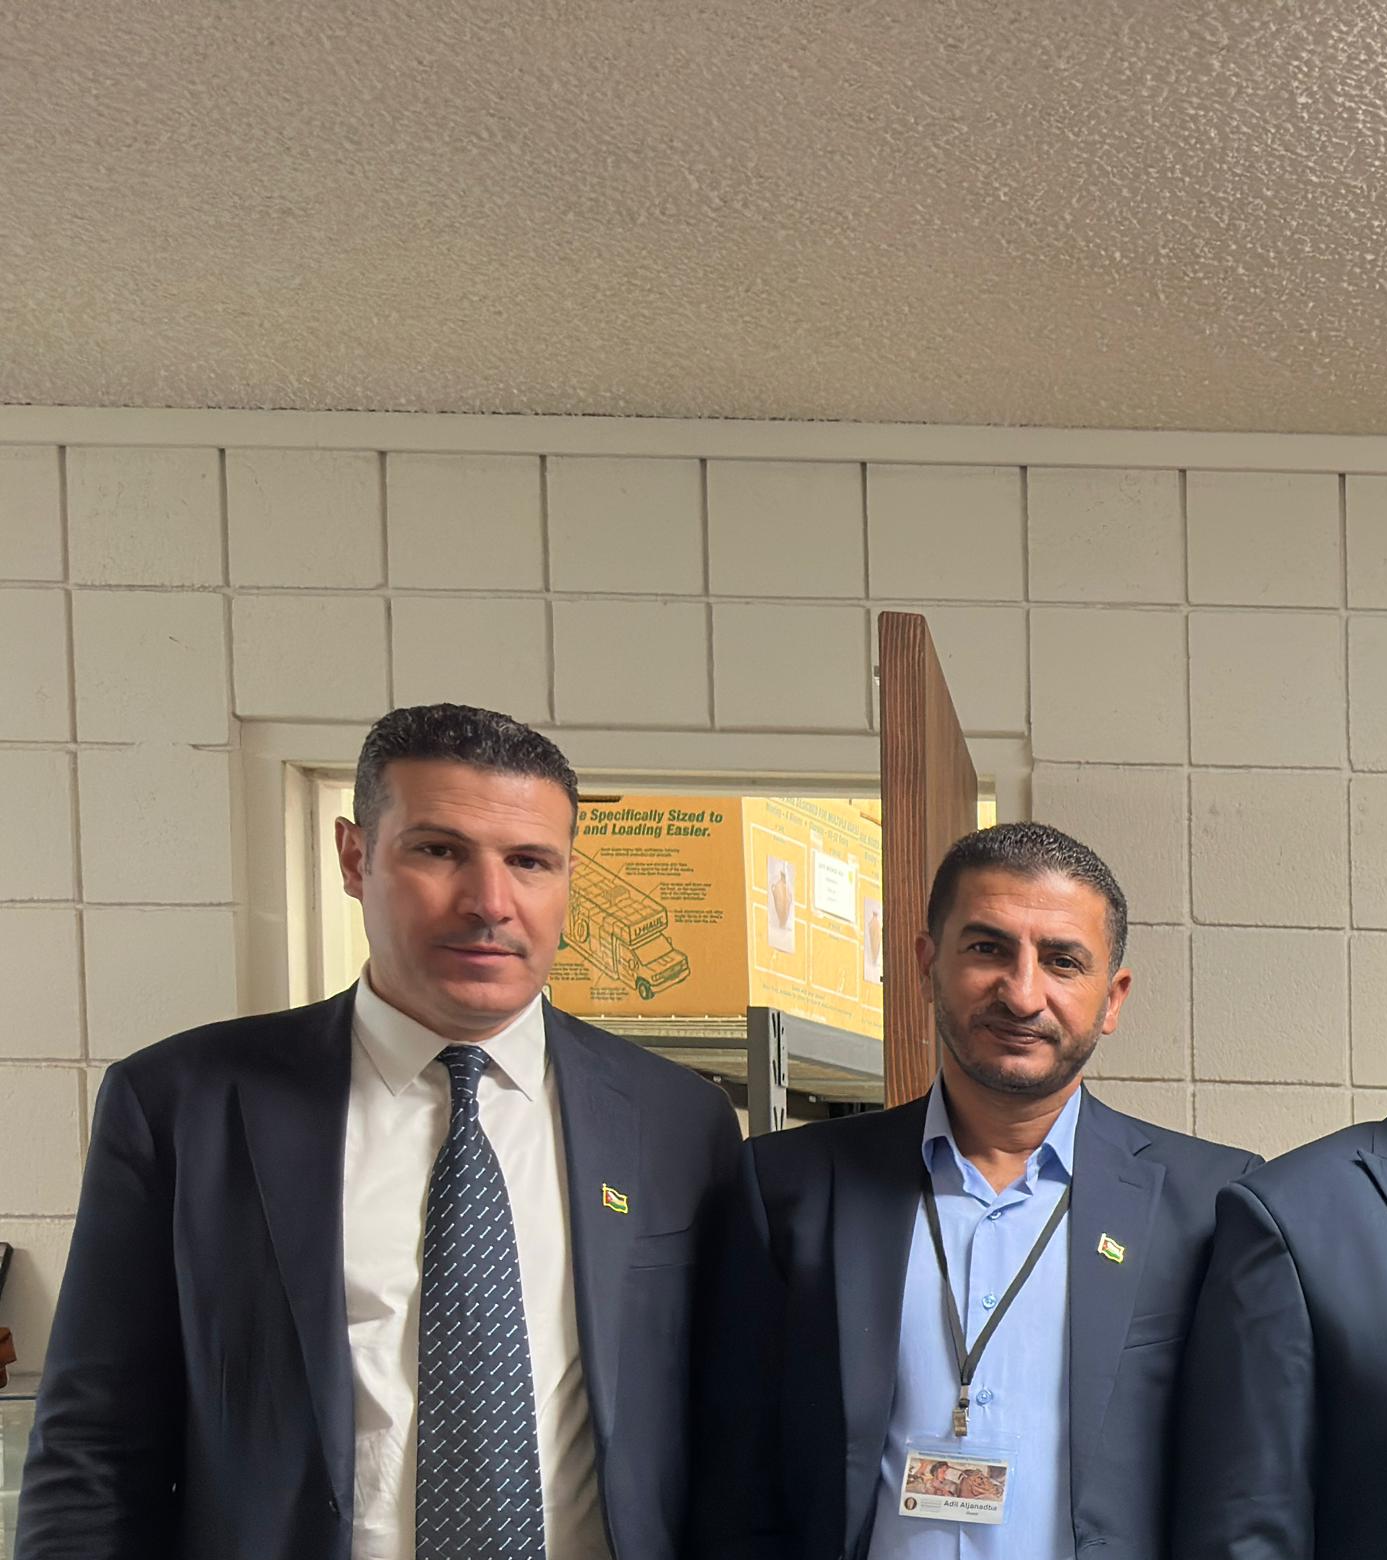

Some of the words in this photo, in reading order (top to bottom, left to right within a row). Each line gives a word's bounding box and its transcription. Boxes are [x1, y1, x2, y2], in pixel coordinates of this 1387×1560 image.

[590, 808, 664, 824] Specifically
[668, 809, 705, 823] Sized
[709, 811, 723, 823] to
[583, 824, 608, 836] and
[611, 823, 662, 838] Loading
[666, 824, 711, 837] Easier.
